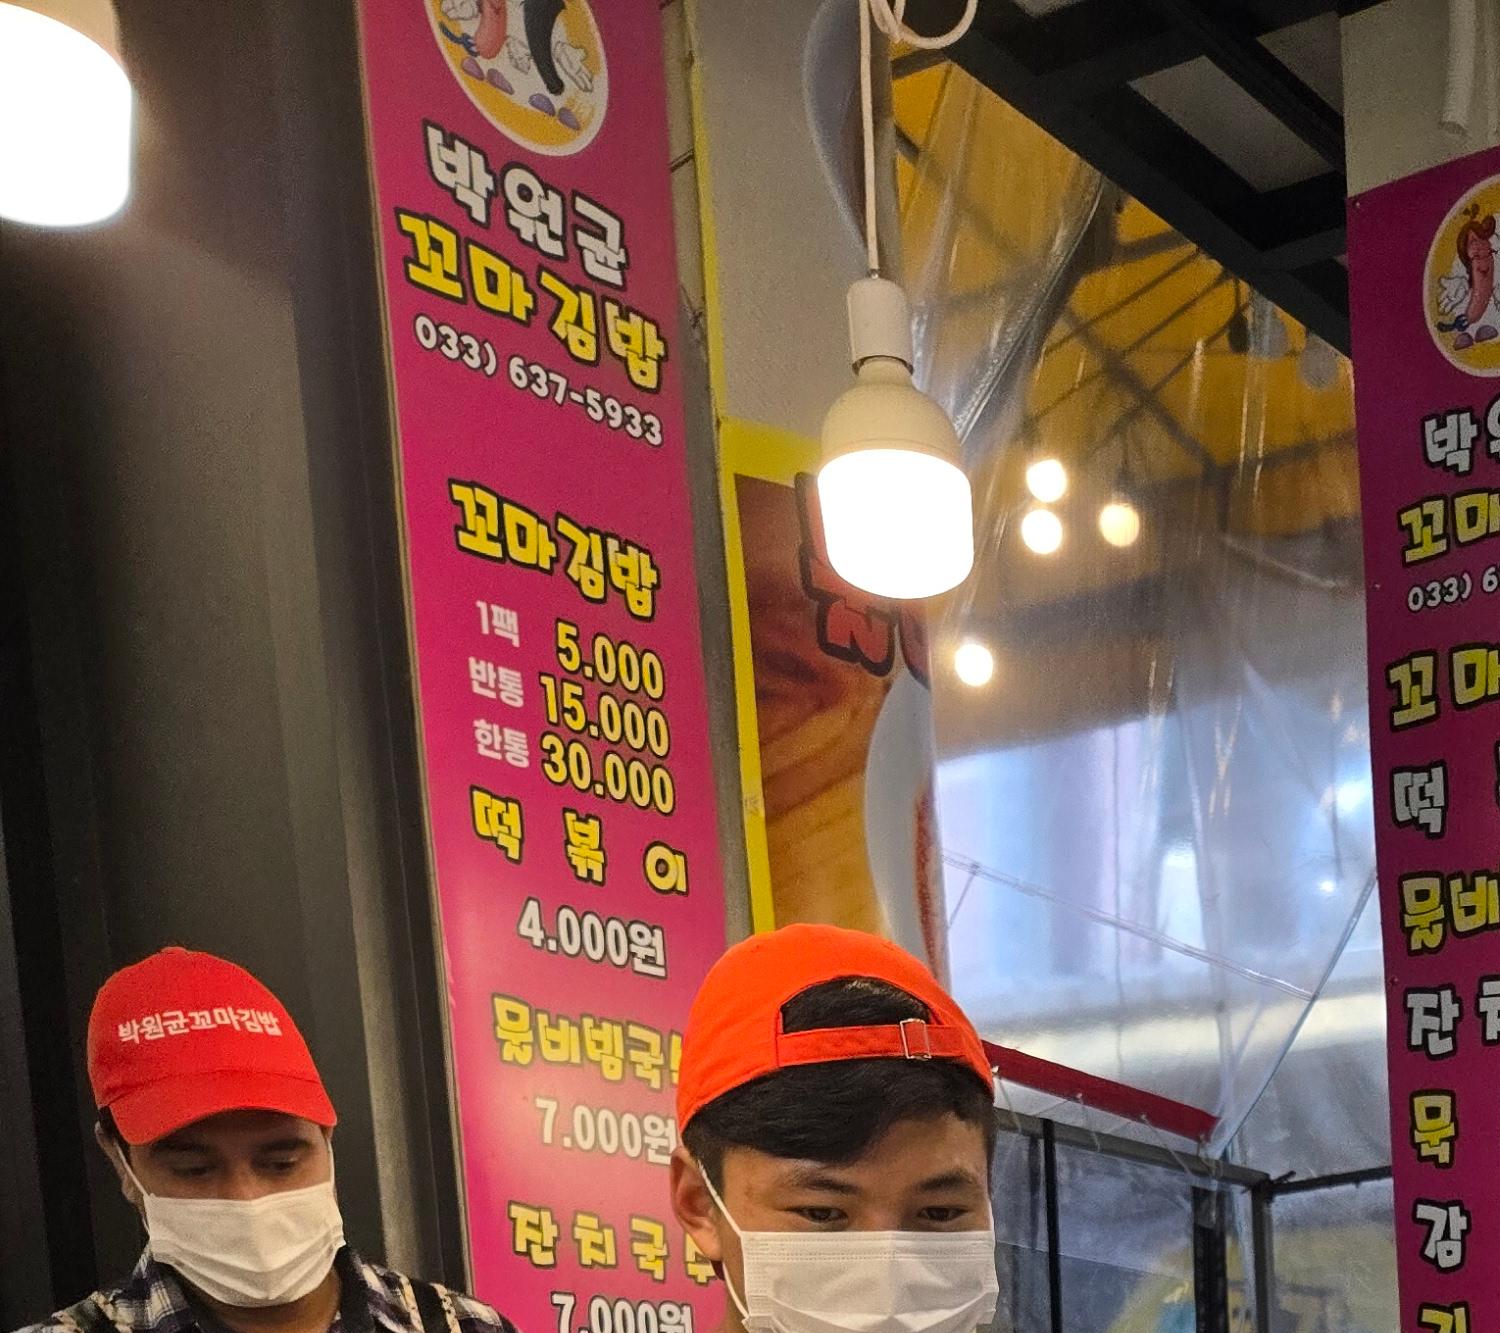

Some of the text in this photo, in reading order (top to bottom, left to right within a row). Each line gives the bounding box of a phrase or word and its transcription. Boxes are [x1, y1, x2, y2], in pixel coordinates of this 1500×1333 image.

[397, 208, 667, 393] 꼬마김밥
[414, 315, 663, 446] 033) 637-5933
[448, 479, 660, 620] 꼬마김밥
[1407, 573, 1473, 612] 033)
[476, 600, 520, 648] 1팩
[468, 656, 524, 708] 반통
[473, 718, 530, 769] 한통
